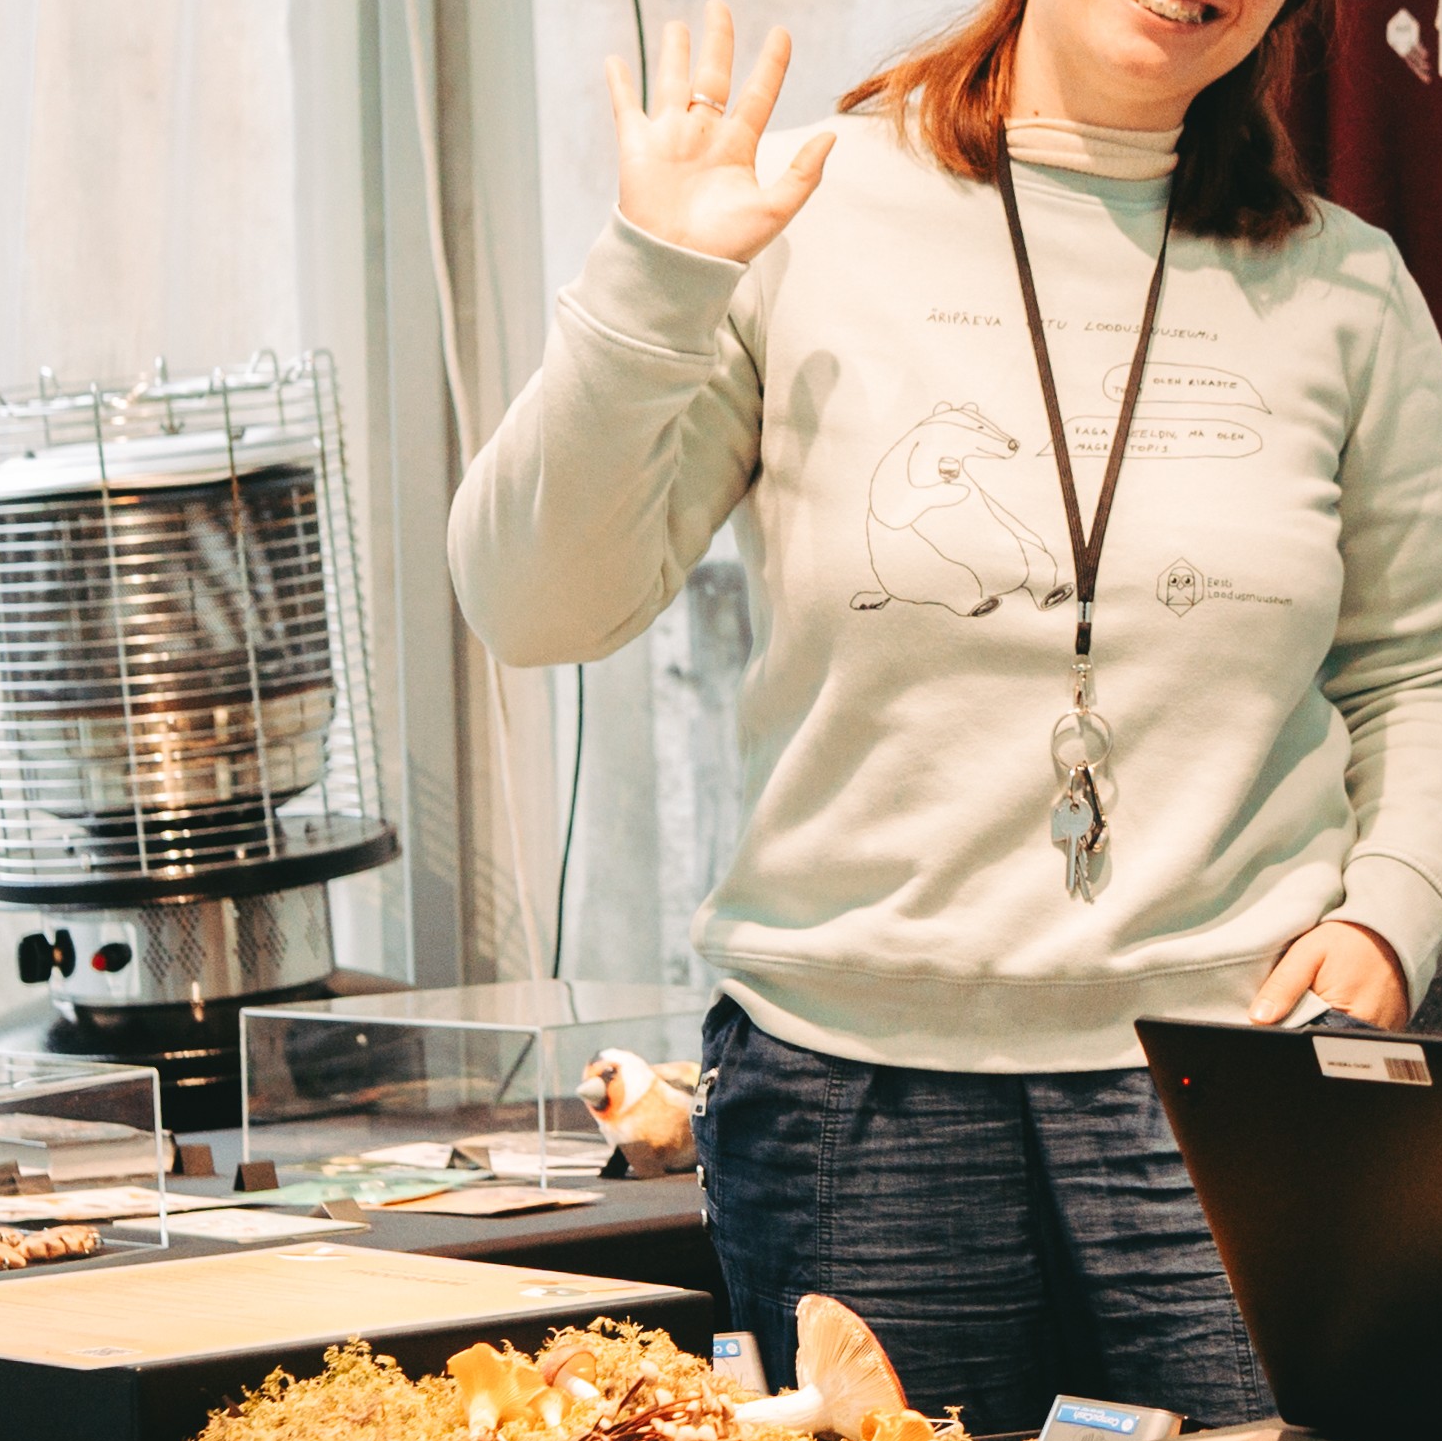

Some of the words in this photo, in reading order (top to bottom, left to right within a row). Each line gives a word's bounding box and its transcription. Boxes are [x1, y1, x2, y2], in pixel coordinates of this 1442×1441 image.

[926, 308, 1002, 327] ÄRIPÄEVA
[1084, 322, 1219, 342] LOODUSUUSEUMIS
[1153, 378, 1182, 386] OLEN
[1188, 430, 1204, 438] MA
[1217, 432, 1245, 440] OLEN
[1075, 442, 1109, 452] MÄGR
[1206, 578, 1233, 588] Eesti
[1207, 590, 1294, 606] Loodusmuuseum
